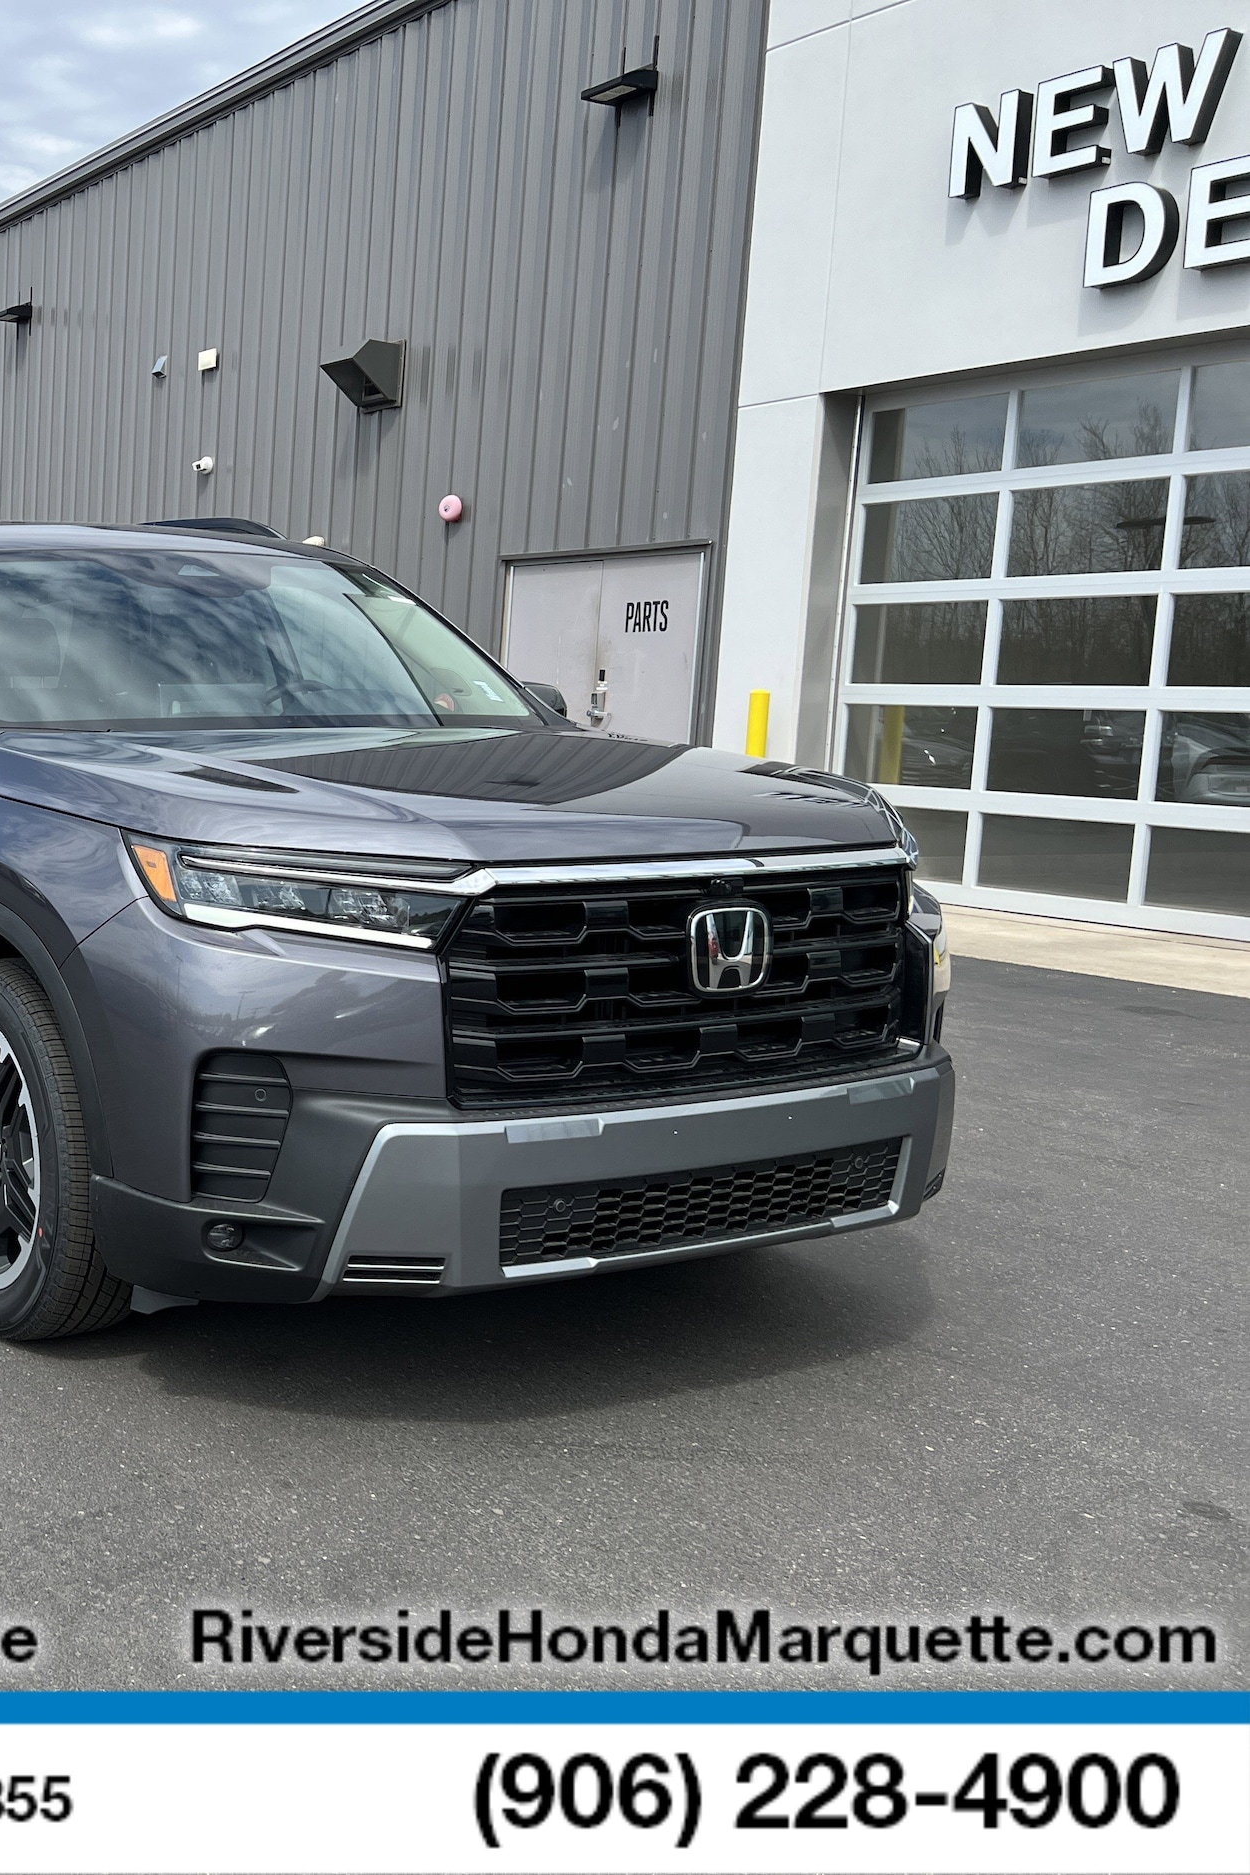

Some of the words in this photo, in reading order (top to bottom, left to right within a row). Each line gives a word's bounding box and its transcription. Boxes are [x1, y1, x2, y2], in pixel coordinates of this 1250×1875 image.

[948, 27, 1244, 200] NEW
[1082, 154, 1250, 290] DE
[624, 599, 669, 633] PARTS
